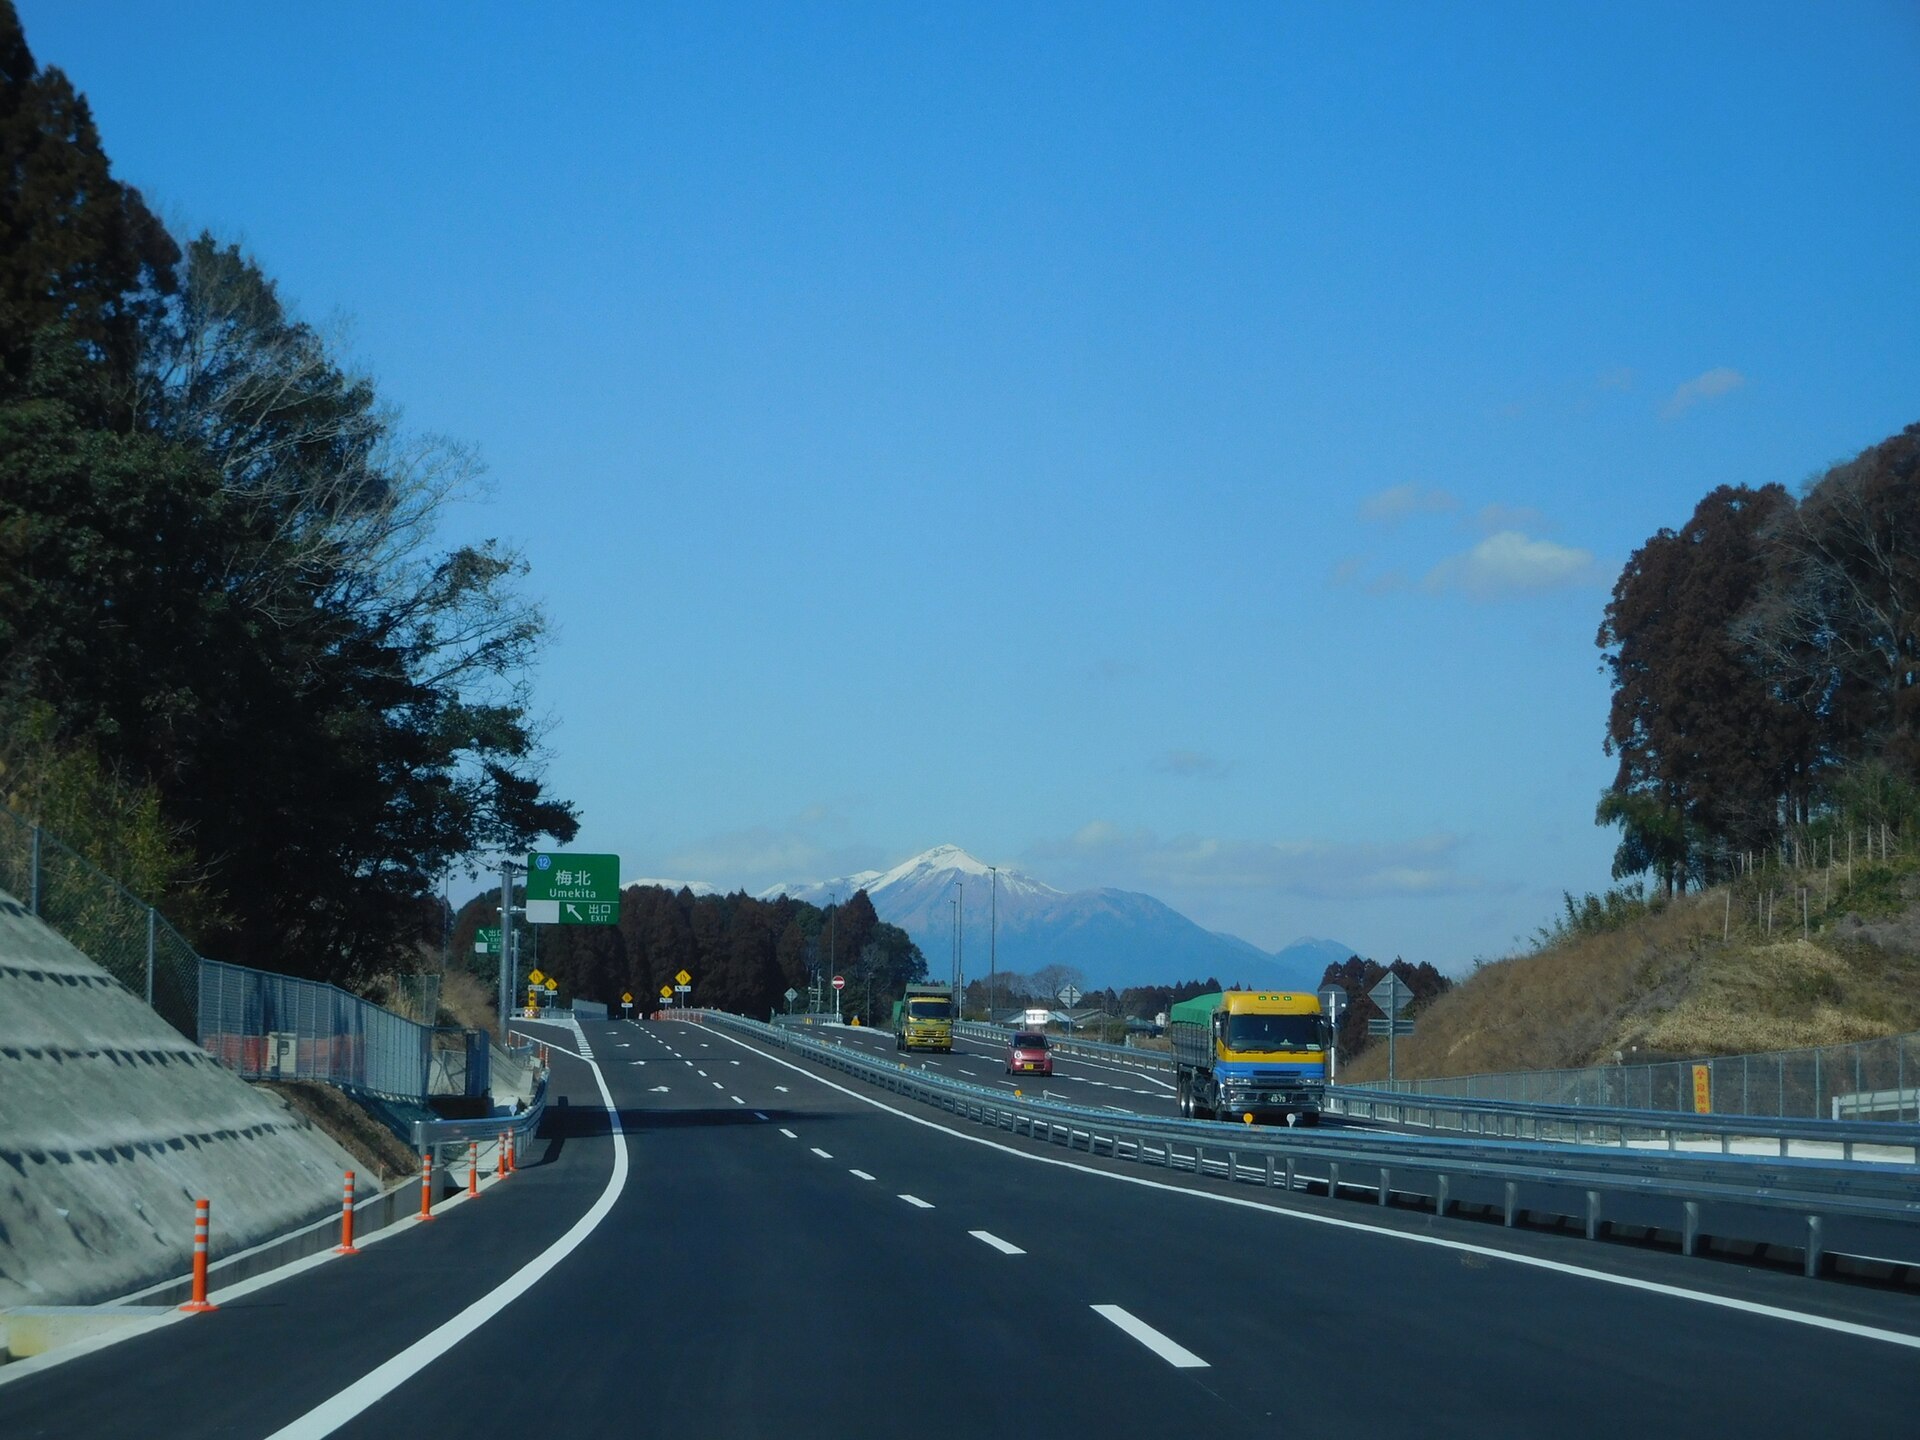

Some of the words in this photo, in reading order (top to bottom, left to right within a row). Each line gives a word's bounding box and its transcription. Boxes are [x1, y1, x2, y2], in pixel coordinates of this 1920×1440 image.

[539, 857, 549, 868] 12
[555, 869, 591, 886] 梅北
[549, 888, 596, 898] Umekita
[588, 904, 611, 914] 出口
